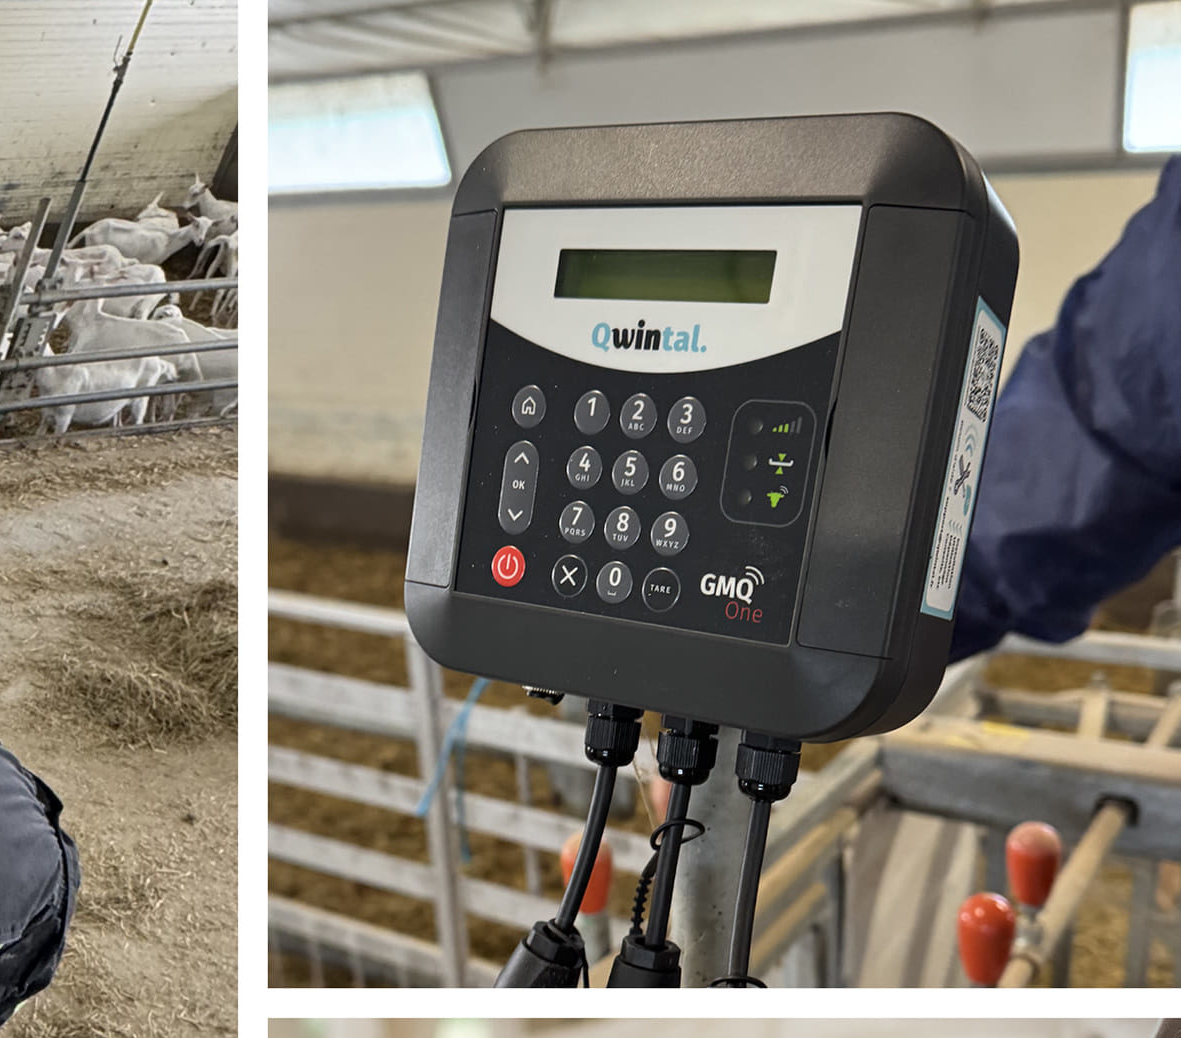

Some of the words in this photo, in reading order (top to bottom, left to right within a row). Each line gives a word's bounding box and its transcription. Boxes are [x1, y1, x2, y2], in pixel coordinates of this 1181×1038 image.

[591, 319, 707, 353] Qwintal.
[587, 396, 597, 417] 1
[631, 400, 645, 420] 2
[679, 403, 693, 425] 3
[627, 423, 645, 431] ABC
[676, 426, 693, 435] DEF
[578, 453, 591, 472] 4
[624, 456, 637, 477] 5
[672, 461, 685, 482] 6
[512, 480, 525, 490] OK
[574, 473, 590, 482] GHI
[620, 479, 635, 487] JKL
[666, 484, 686, 493] MNO
[571, 506, 583, 526] 7
[616, 512, 630, 532] 8
[564, 527, 586, 537] PQRS
[612, 533, 629, 542] TUV
[663, 517, 677, 538] 9
[655, 539, 679, 549] WXYZ
[608, 566, 622, 587] 0
[650, 584, 671, 594] TARE
[700, 573, 754, 604] GMQ
[725, 601, 763, 624] One
